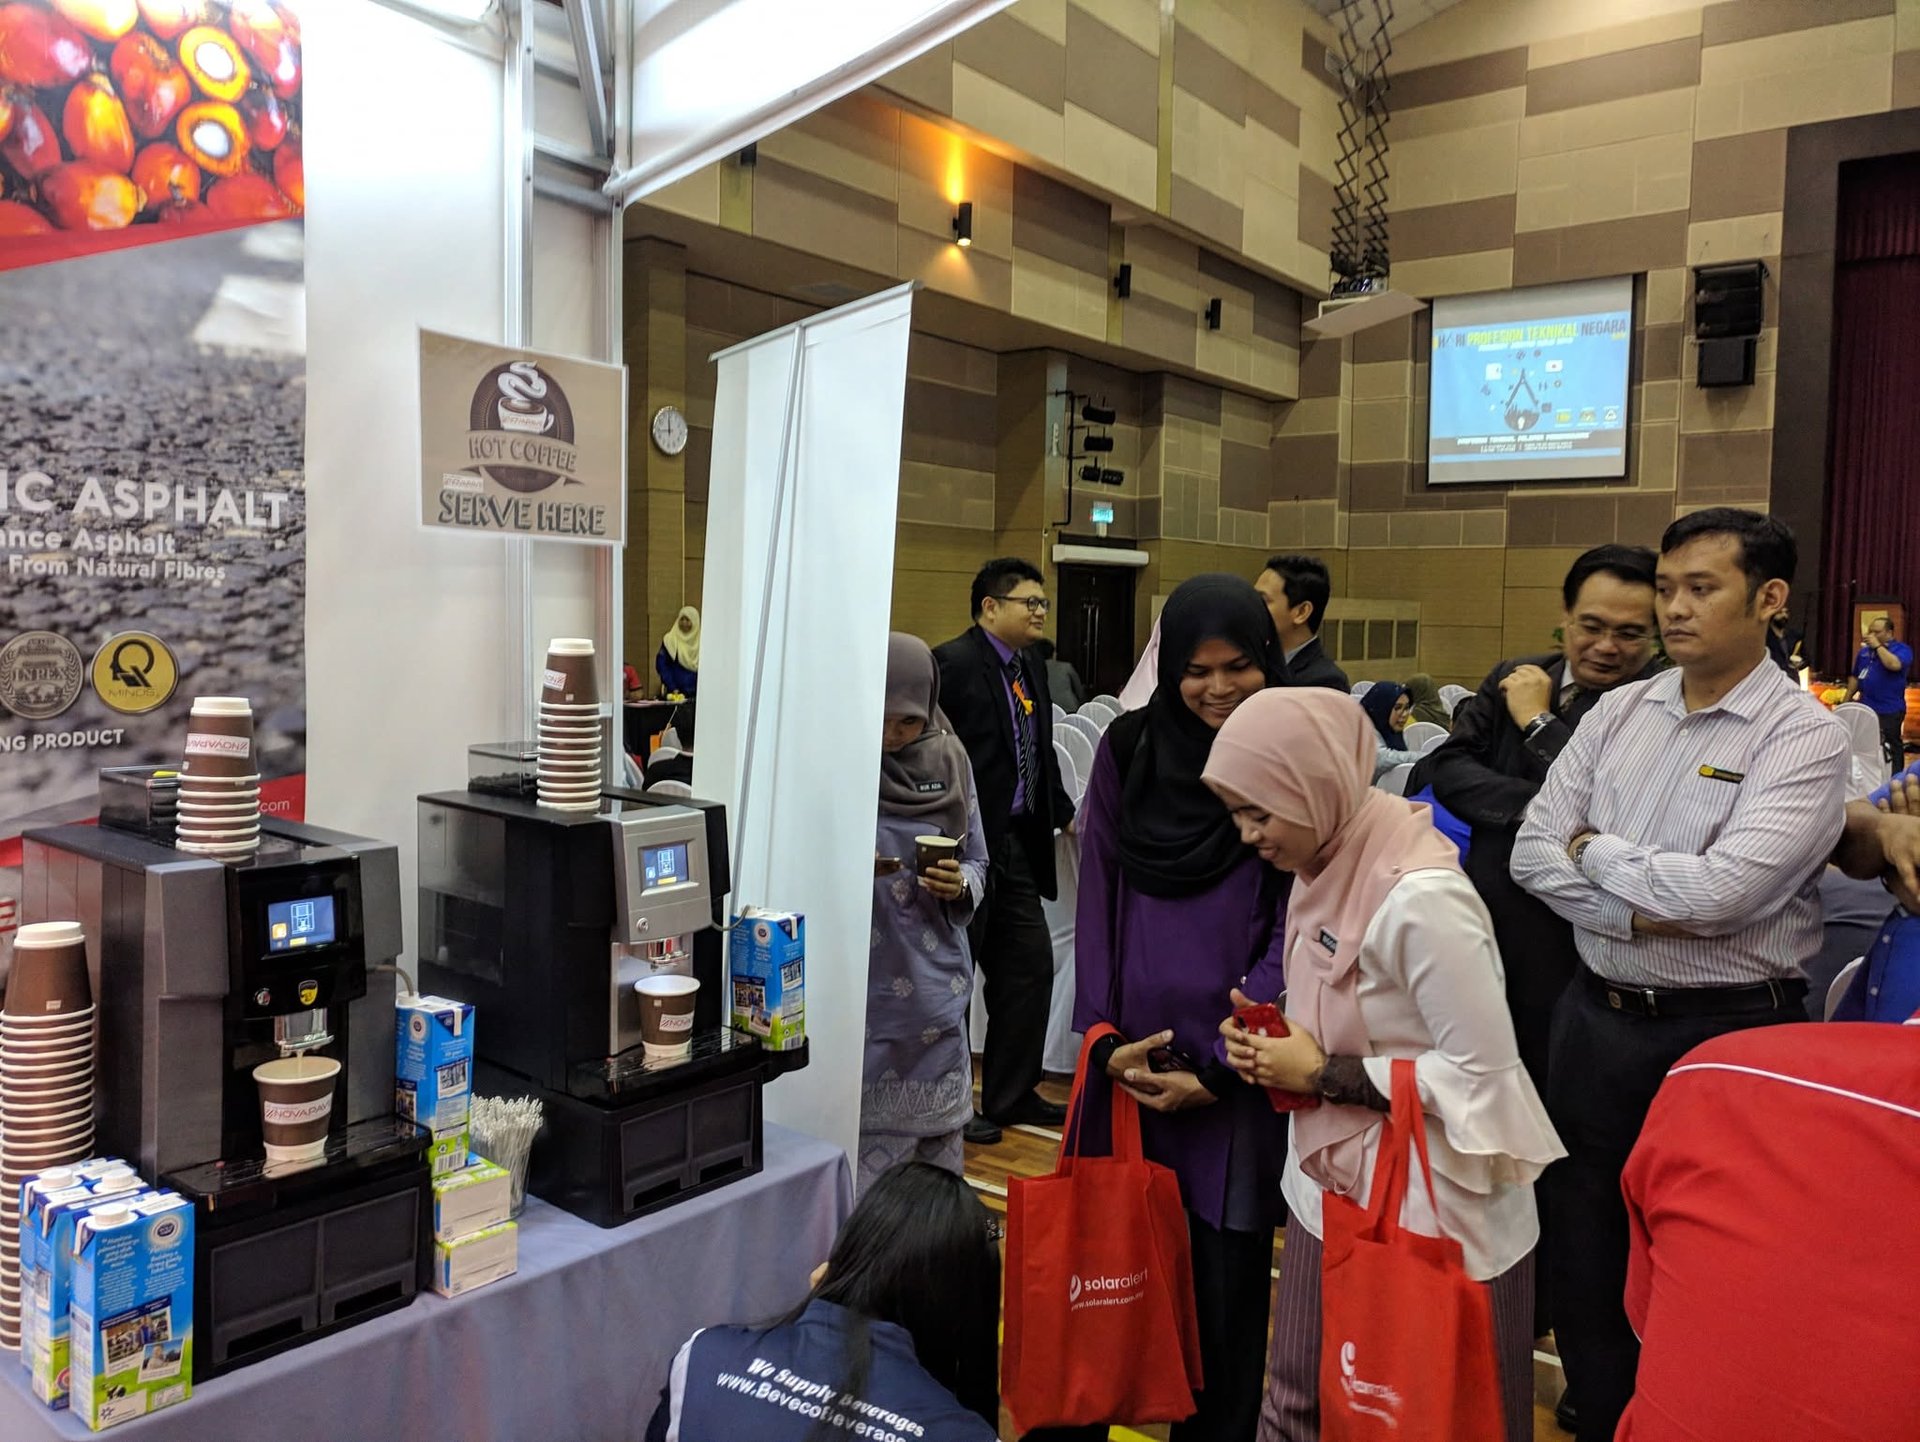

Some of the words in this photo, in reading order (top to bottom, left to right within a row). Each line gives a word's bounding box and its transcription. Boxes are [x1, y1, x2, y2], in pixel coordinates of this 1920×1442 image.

[468, 435, 506, 460] HOT
[510, 438, 577, 473] COFFEE
[72, 476, 289, 528] ASPHALT
[438, 489, 532, 530] SERVE
[536, 501, 606, 535] HERE
[72, 528, 176, 556] Asphalt
[9, 554, 69, 576] From
[76, 560, 156, 579] Natural
[164, 560, 226, 581] Fibres
[33, 728, 125, 751] PRODUCT
[1084, 1267, 1148, 1291] solaralert
[747, 1357, 777, 1378] We
[773, 1368, 838, 1404] Supply
[839, 1393, 926, 1438] Beverages
